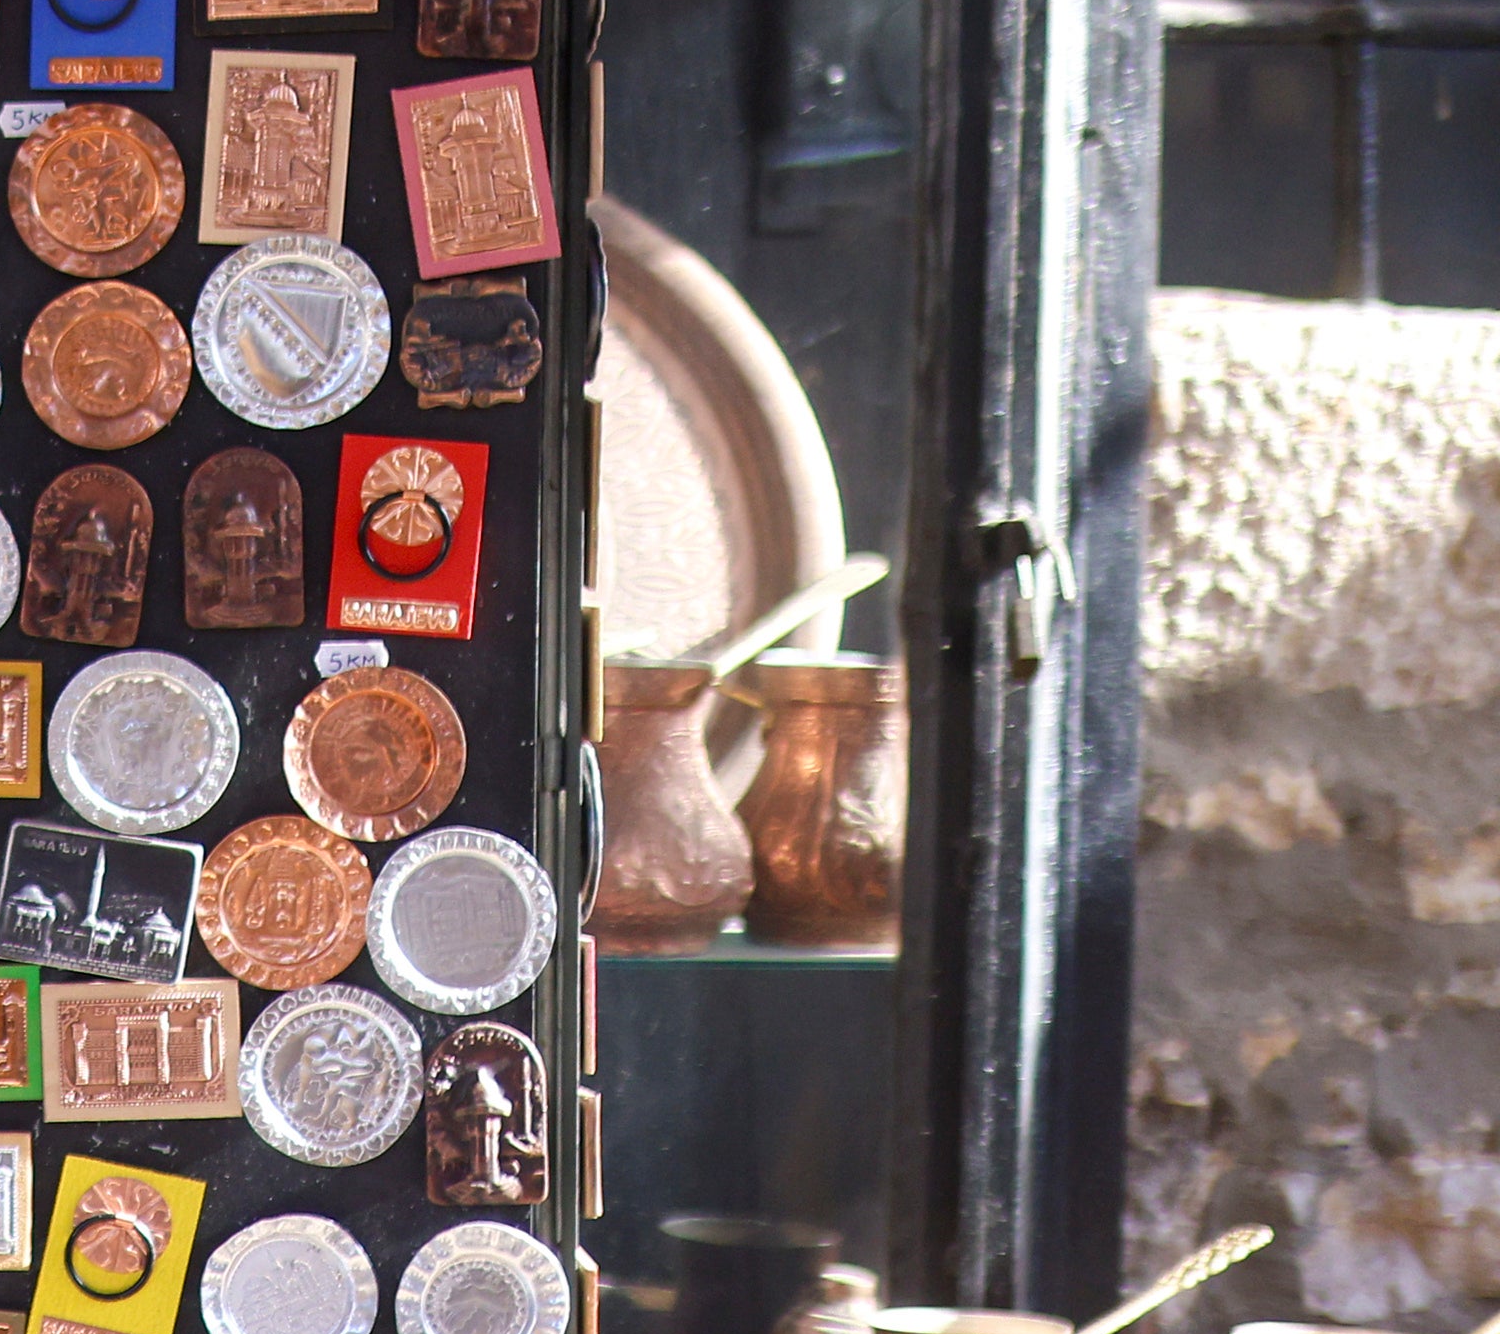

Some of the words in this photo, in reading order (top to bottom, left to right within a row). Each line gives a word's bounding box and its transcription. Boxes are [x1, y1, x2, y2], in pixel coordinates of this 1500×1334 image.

[51, 63, 161, 83] SARAJEVO
[12, 111, 25, 131] 5
[343, 600, 458, 631] SARAJEVO
[330, 653, 342, 673] 5
[347, 656, 377, 669] KM
[94, 1002, 192, 1017] SARAJEVO
